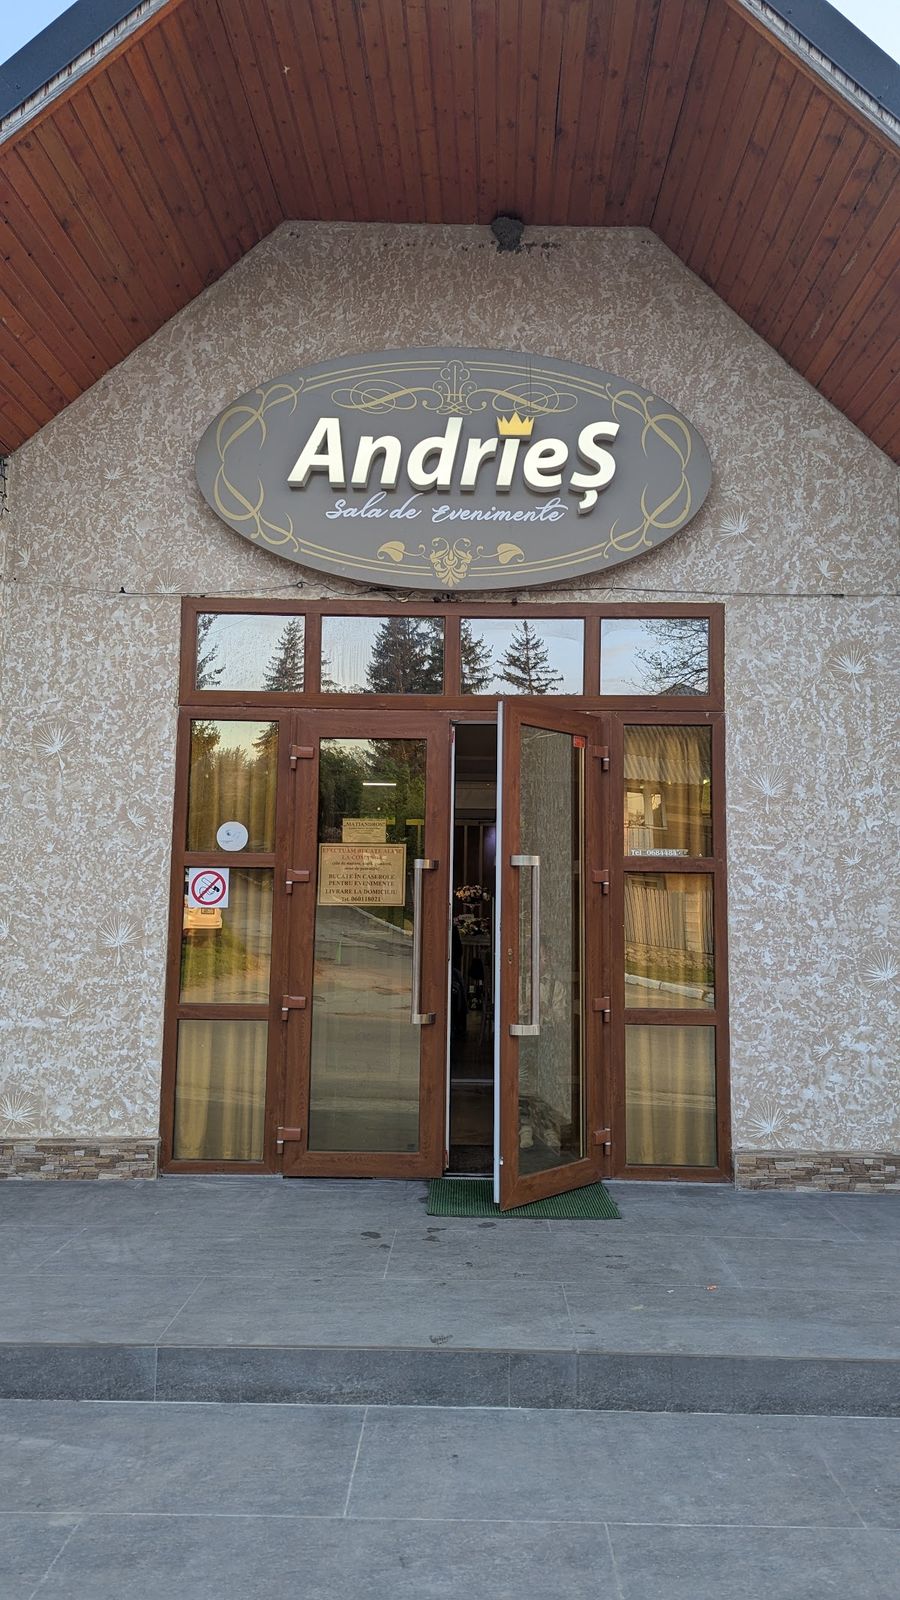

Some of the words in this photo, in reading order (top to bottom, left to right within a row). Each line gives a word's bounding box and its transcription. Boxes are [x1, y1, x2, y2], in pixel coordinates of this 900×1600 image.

[325, 491, 391, 522] Sala
[389, 492, 424, 520] de
[431, 496, 569, 525] Evenimente
